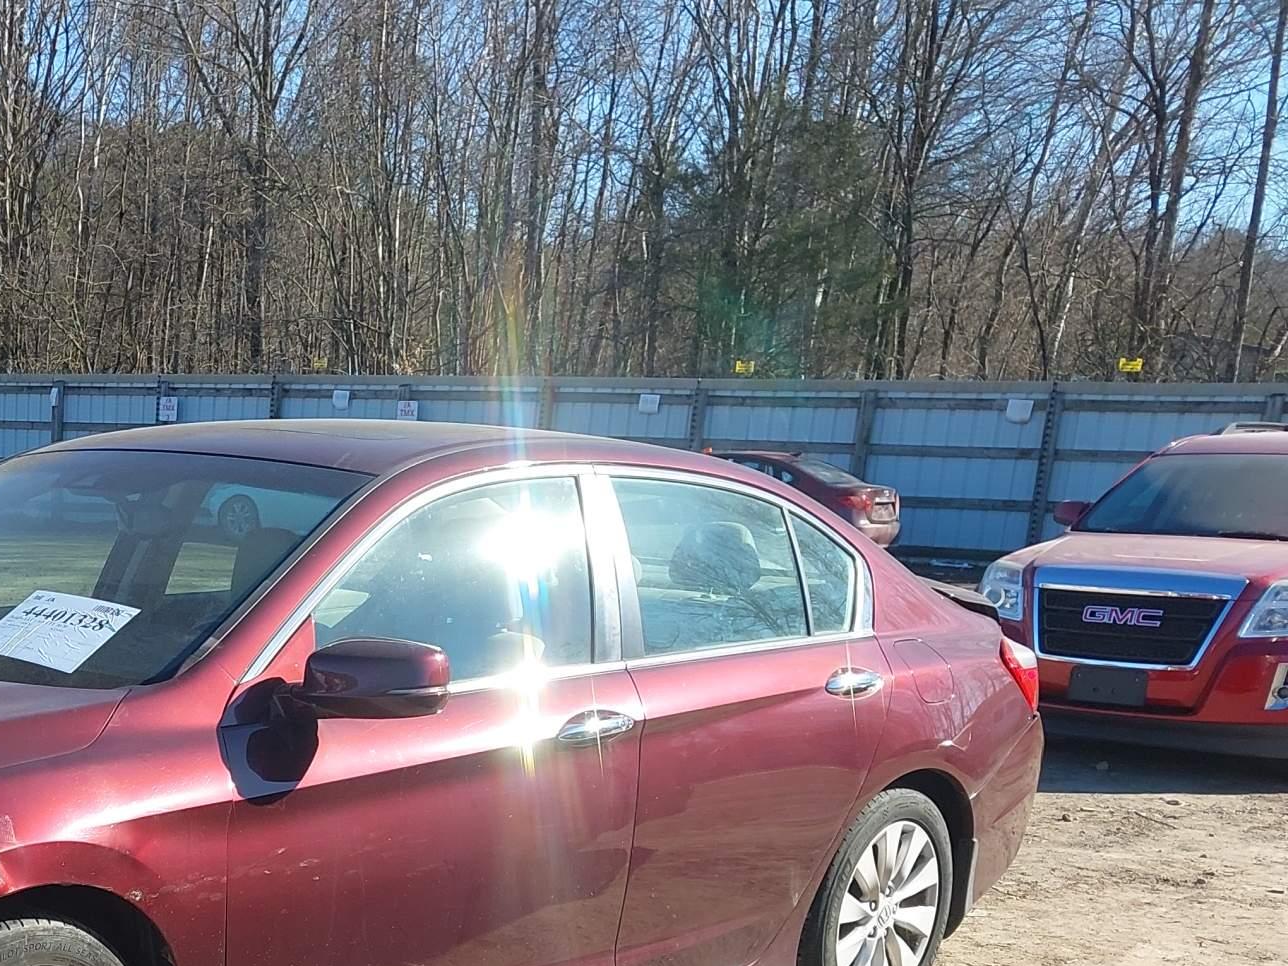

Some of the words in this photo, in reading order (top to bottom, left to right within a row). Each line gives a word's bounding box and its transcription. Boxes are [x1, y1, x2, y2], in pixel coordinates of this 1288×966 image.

[23, 605, 109, 631] 44401328
[1082, 605, 1164, 627] GMC
[24, 942, 53, 953] SPORT
[56, 942, 73, 953] ALL
